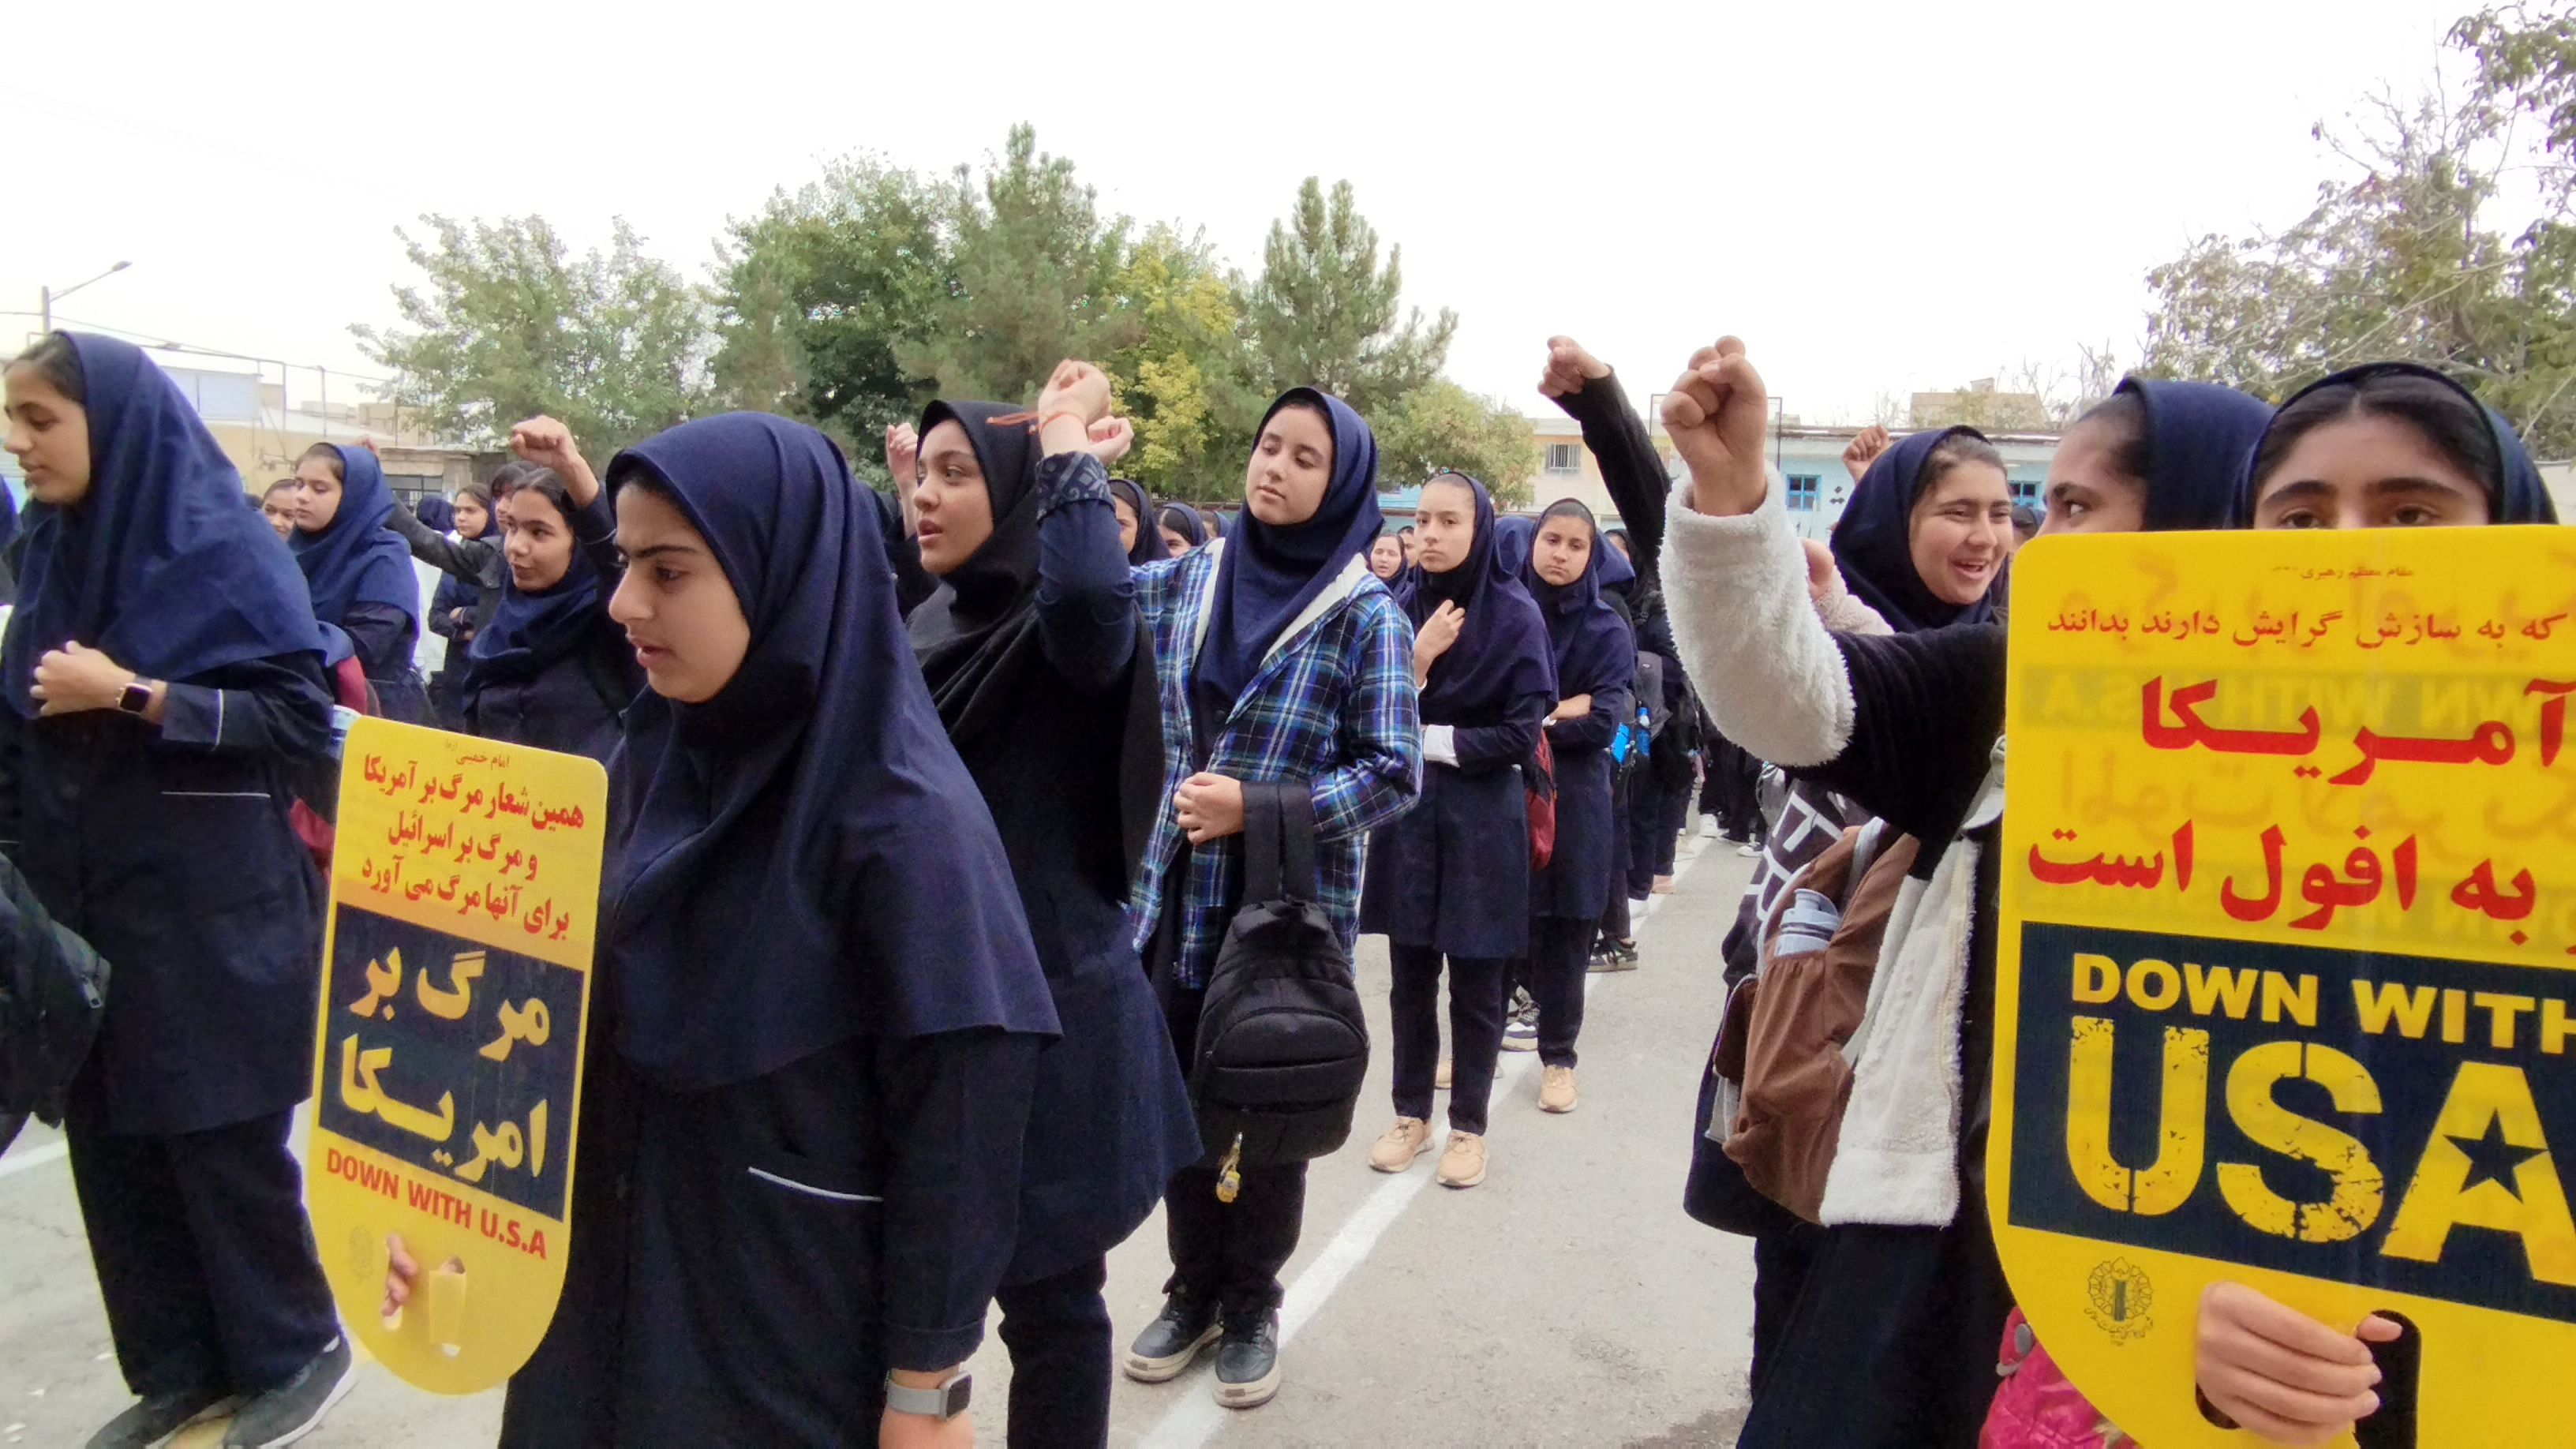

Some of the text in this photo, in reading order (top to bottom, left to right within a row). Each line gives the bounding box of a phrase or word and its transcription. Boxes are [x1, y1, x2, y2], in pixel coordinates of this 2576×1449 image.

[2047, 608, 2568, 650] که به سازش گرایش دارند بدانند
[2141, 675, 2576, 787] آمریکا
[365, 754, 585, 832] همین شعار مرگ بر آمریکا
[388, 810, 539, 882] و مرگ بر اسرائیل
[361, 855, 570, 941] برای آنها مرگ می آورد
[2027, 818, 2537, 946] به افول است
[349, 946, 551, 1062] مرگ بر
[2071, 952, 2576, 1056] DOWN WITH
[341, 1032, 549, 1183] امریکا
[2065, 1014, 2576, 1289] USA
[326, 1147, 548, 1260] DOWN WITH U.S.A
